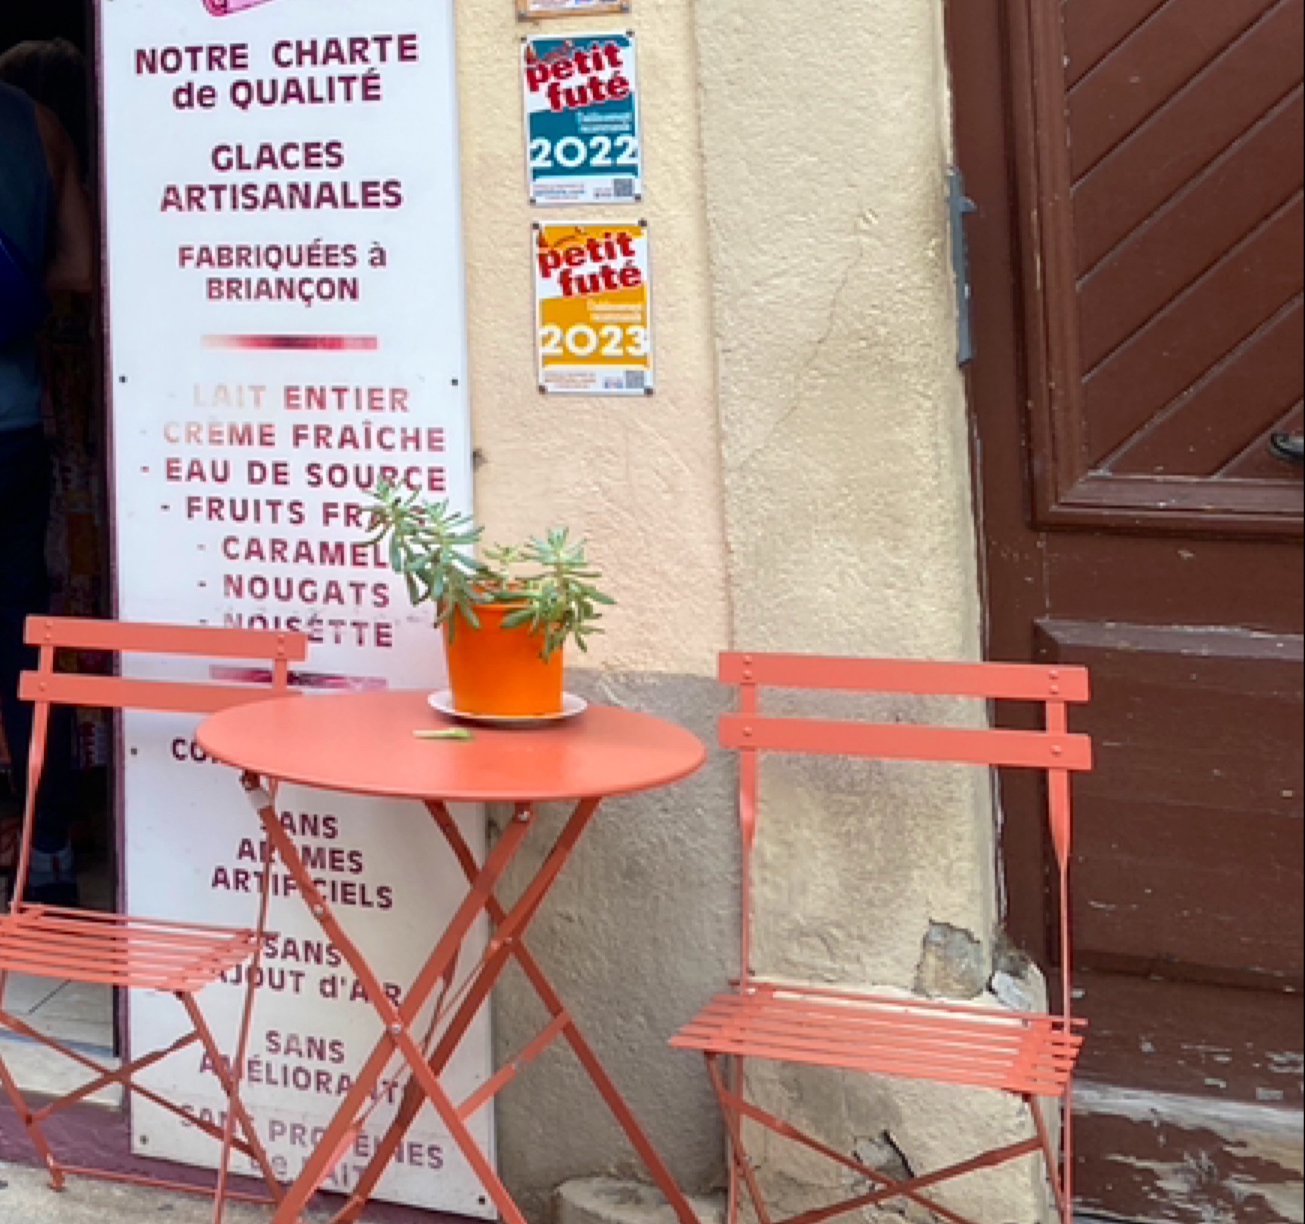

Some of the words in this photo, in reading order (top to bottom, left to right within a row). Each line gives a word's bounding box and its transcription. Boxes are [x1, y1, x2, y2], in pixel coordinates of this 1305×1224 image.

[135, 43, 249, 74] NOTRE
[272, 34, 419, 68] CHARTE
[525, 41, 624, 93] petit
[173, 82, 217, 109] de
[230, 68, 382, 110] QUALITÉ
[211, 140, 345, 172] GLACES
[530, 136, 639, 168] 2022
[160, 179, 404, 212] ARTISANALES
[178, 238, 358, 271] FABRIQUÉES
[368, 241, 388, 267] à
[537, 231, 636, 279] petit
[206, 277, 359, 307] BRIANÇON
[538, 325, 651, 358] 2023
[194, 385, 267, 408] LAIT
[284, 386, 410, 413] ENTIER
[163, 417, 276, 447] CRÈME
[292, 419, 446, 452] FRAÎCHE
[165, 457, 231, 482] EAU
[247, 460, 290, 485] DE
[305, 463, 446, 491] SOURCE
[186, 496, 306, 524] FRUITS
[222, 536, 390, 569] CARAMEL
[223, 574, 391, 608] NOUGATS
[260, 810, 339, 839] ANS
[236, 838, 364, 873] ARMES
[211, 865, 393, 909] ARTIFCIELS
[264, 936, 342, 968] SANS
[216, 962, 306, 993] JOUT
[319, 975, 403, 1007] d'AR
[265, 1029, 346, 1064] SANS
